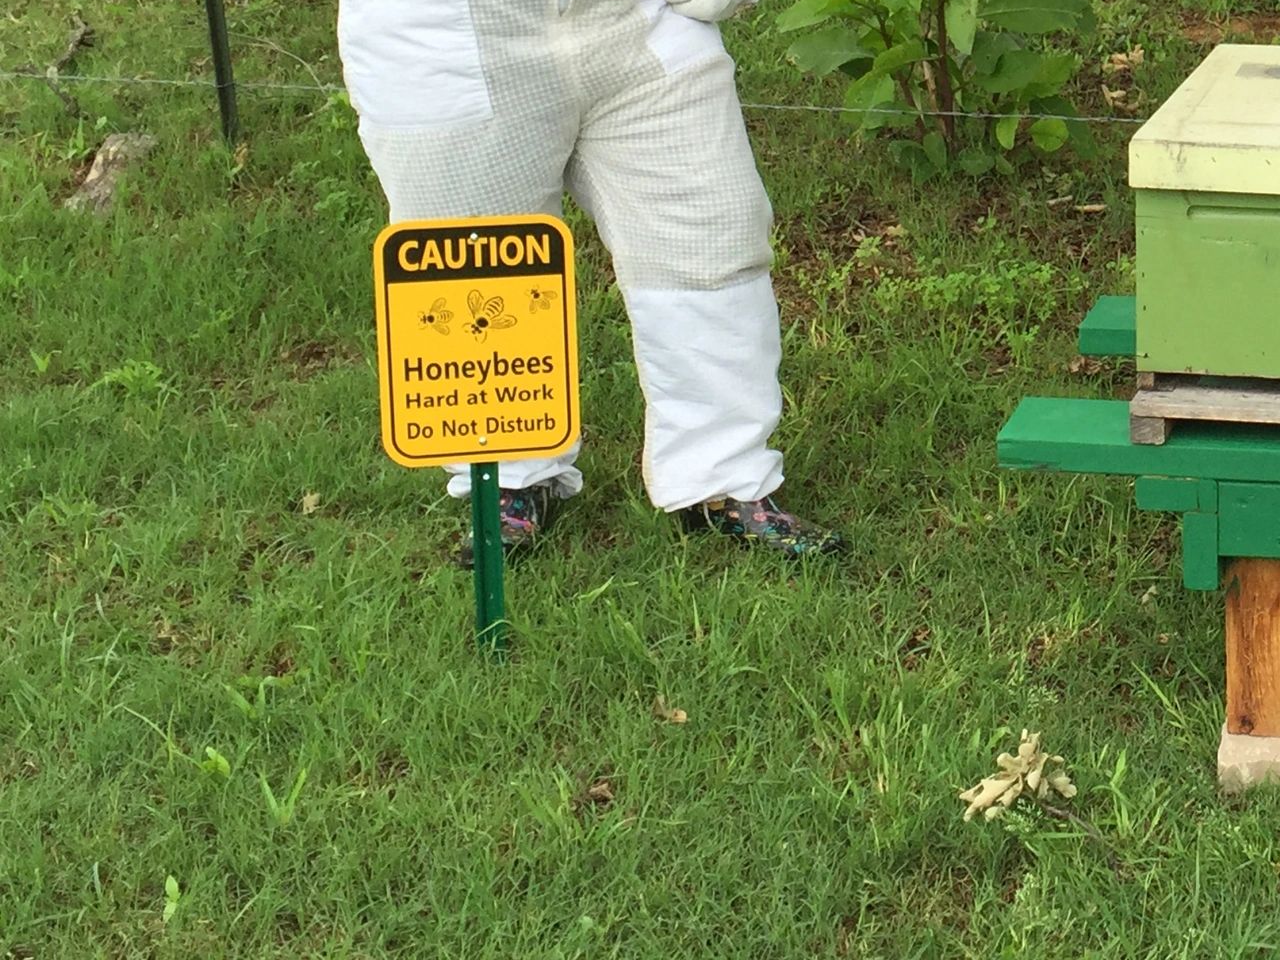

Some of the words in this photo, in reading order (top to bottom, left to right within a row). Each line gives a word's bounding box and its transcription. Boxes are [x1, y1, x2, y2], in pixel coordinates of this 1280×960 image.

[397, 234, 551, 272] CAUTION
[404, 351, 554, 385] Honeybees
[405, 390, 459, 409] Hard
[466, 389, 488, 405] at
[495, 384, 554, 403] Work
[406, 422, 434, 440] Do
[442, 419, 478, 437] Not
[486, 413, 556, 434] Disturb
